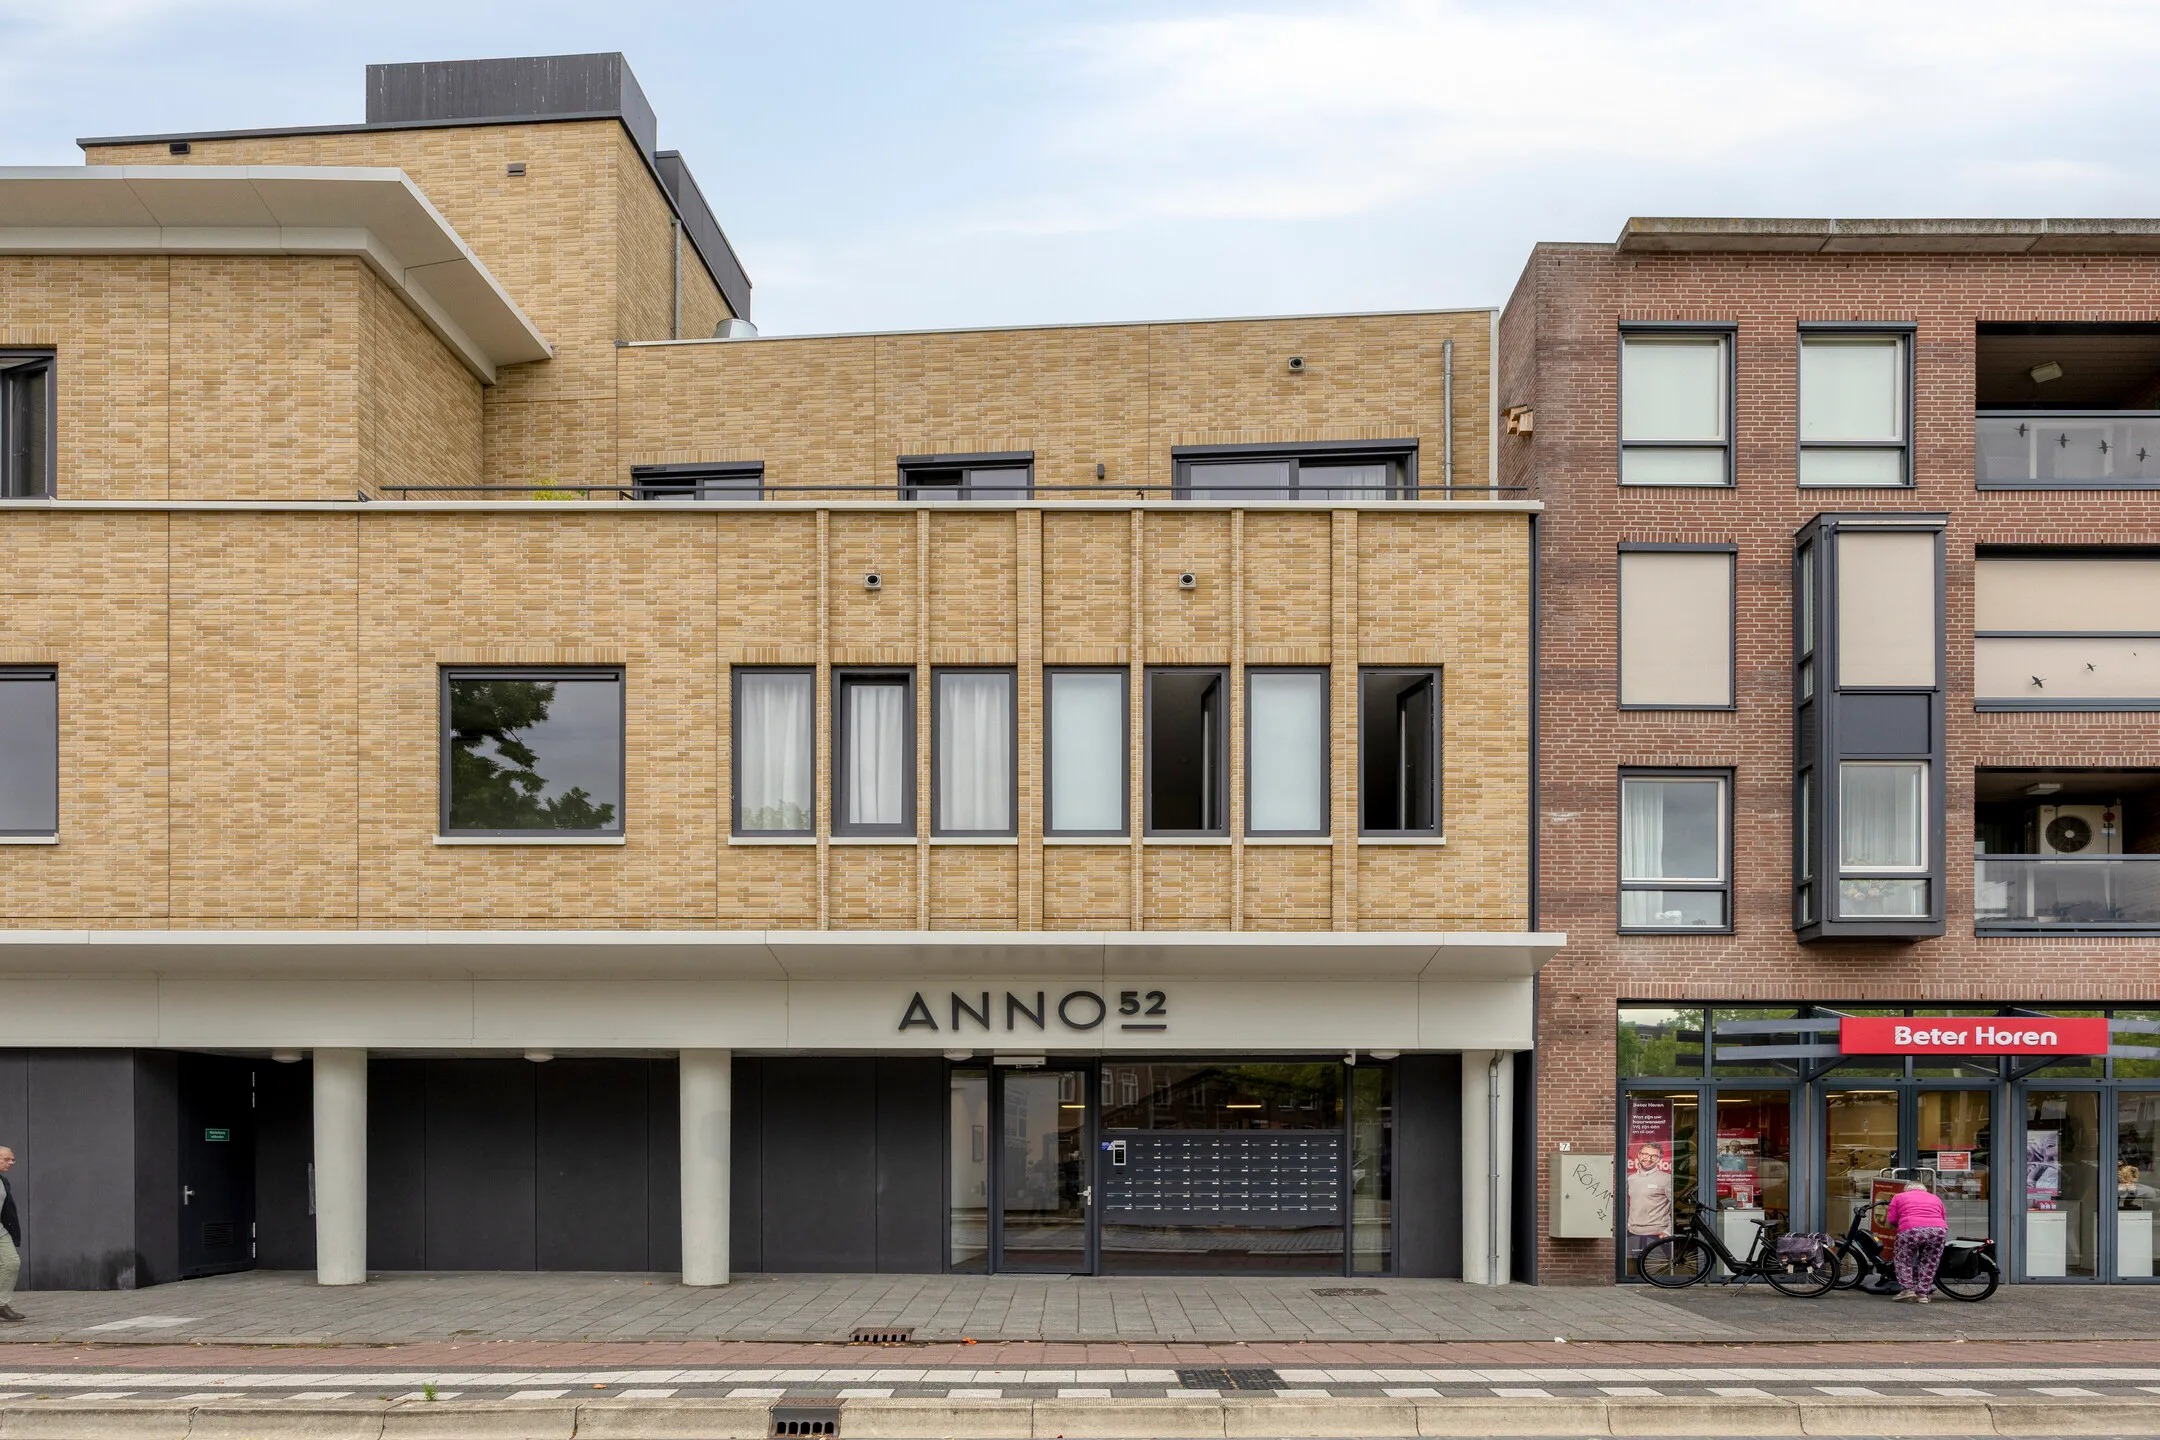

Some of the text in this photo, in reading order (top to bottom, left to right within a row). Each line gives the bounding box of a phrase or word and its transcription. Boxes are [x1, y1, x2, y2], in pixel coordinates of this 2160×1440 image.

[898, 990, 1167, 1031] ANNO 52
[1894, 1026, 2058, 1046] Beter Horen
[1572, 1163, 1612, 1211] ROAM
